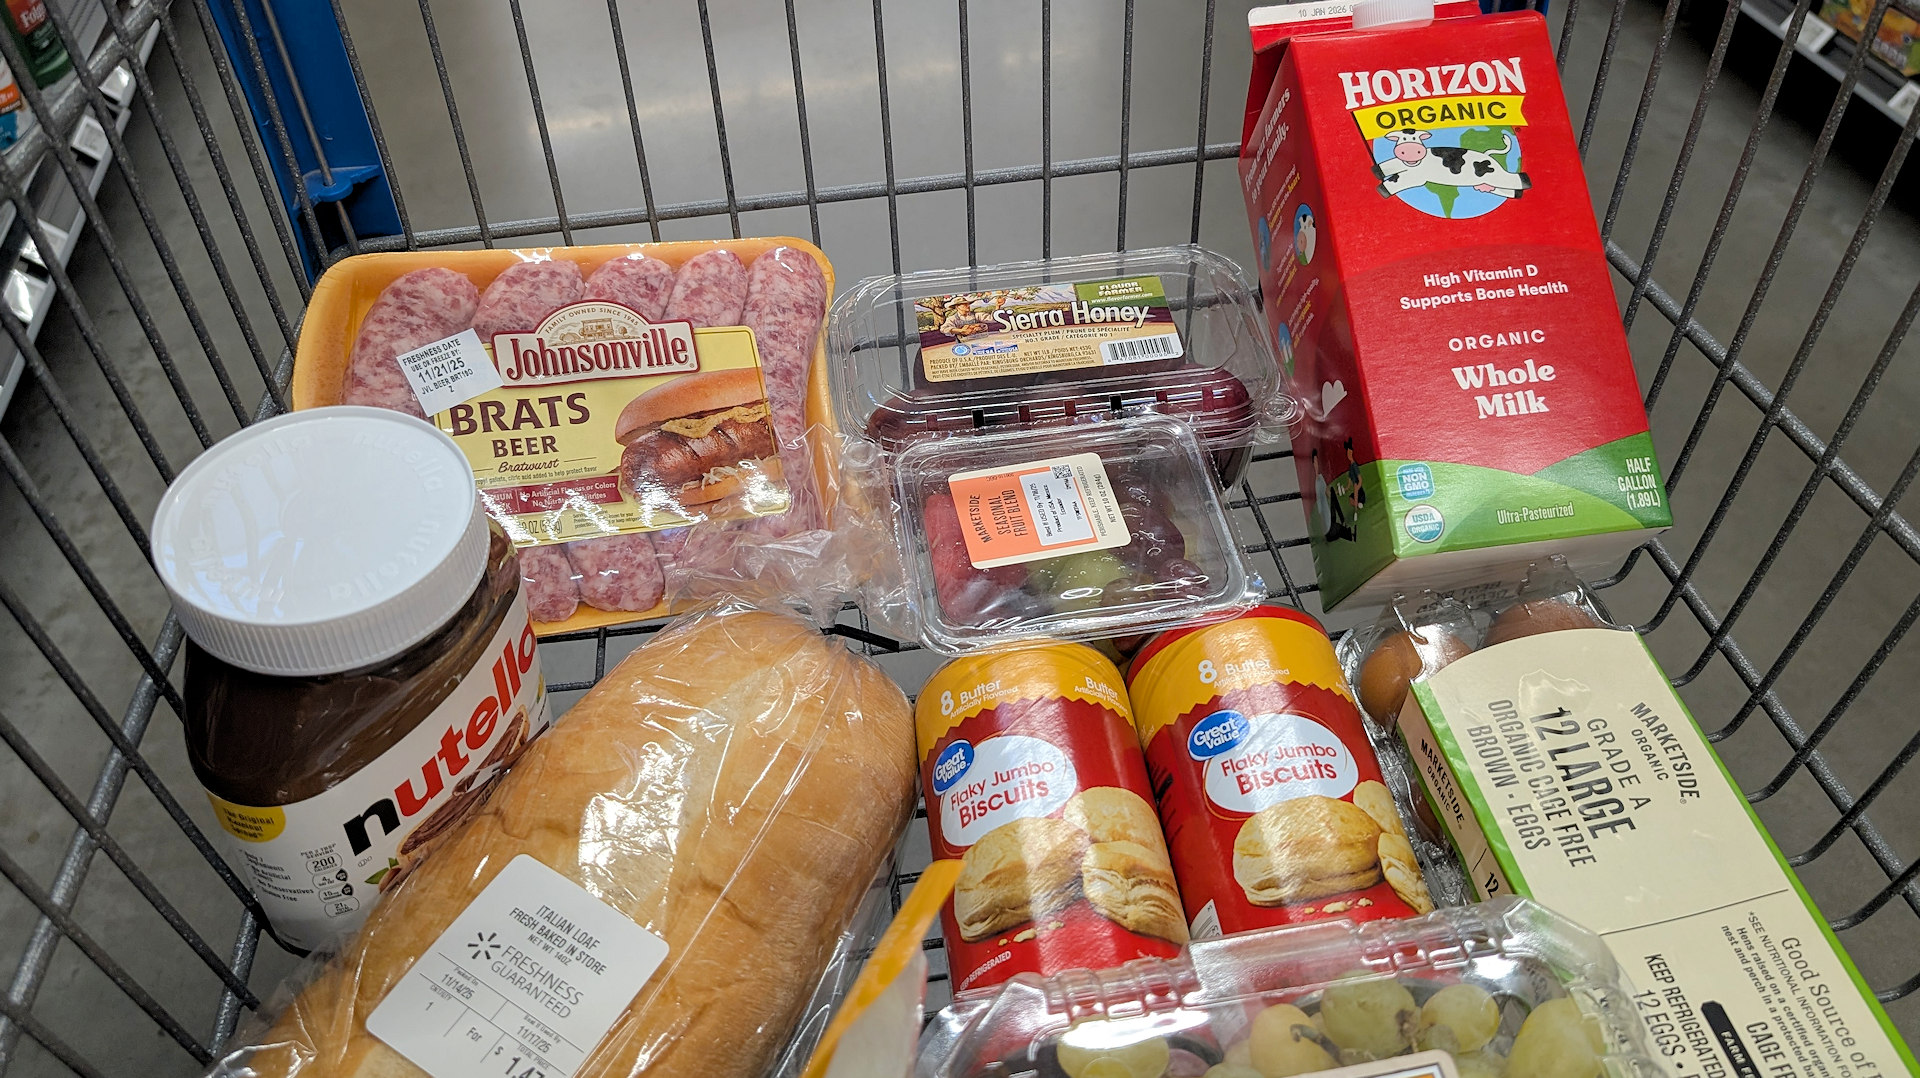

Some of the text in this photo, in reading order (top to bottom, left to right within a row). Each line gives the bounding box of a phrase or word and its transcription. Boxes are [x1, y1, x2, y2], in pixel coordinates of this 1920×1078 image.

[1311, 8, 1325, 16] JAN
[1328, 6, 1347, 15] 2026
[1338, 57, 1526, 110] HORIZON
[1264, 87, 1291, 142] farmers
[1375, 101, 1507, 130] ORGANIC
[1287, 171, 1300, 193] heart
[1099, 281, 1139, 291] FLAVOR
[1423, 264, 1538, 288] High Vitamin D
[1098, 287, 1143, 297] FARMER
[1400, 280, 1569, 311] Supports Bone Health
[545, 307, 639, 334] FAMILY OWNED SINCE 1945
[993, 300, 1150, 334] Sierra Honey
[1012, 332, 1042, 340] SPECIALTY
[1449, 329, 1545, 352] ORGANIC
[402, 338, 461, 366] FRESHNESS DATE
[422, 360, 431, 368] OR
[431, 352, 451, 364] FREEZE
[506, 328, 690, 381] Johnsonville
[992, 357, 1018, 365] KINGSBURG
[418, 357, 465, 383] 11/21/25
[433, 378, 451, 390] BEER
[1451, 359, 1556, 390] Whole
[449, 392, 590, 437] BRATS
[1474, 390, 1549, 420] Milk
[492, 435, 560, 458] BEER
[498, 458, 560, 474] Bratwurst
[533, 465, 598, 479] added help protect flavor
[1402, 472, 1427, 484] NON
[1625, 457, 1652, 474] HALF
[531, 488, 560, 498] Artificial
[594, 481, 616, 490] Colors
[1404, 481, 1429, 492] GMO
[1617, 473, 1656, 493] GALLON
[1002, 489, 1029, 537] FRUIT BLEND
[1104, 505, 1116, 523] NET WT
[1497, 502, 1575, 525] Ultra-Pasteurized
[1627, 489, 1661, 511] (1.89L)
[528, 521, 540, 534] OZ
[969, 494, 992, 543] MARKETSIDE
[988, 496, 1012, 535] SEASONAL
[1411, 523, 1439, 534] ORGANIC
[1412, 513, 1435, 523] USDA
[1198, 658, 1271, 684] 8 Butter
[940, 680, 1001, 716] 8 Butter
[1074, 686, 1106, 702] Artificially
[1085, 676, 1119, 700] Butter
[950, 686, 1019, 720] Artificially Flavored
[343, 622, 536, 857] nutella
[1193, 717, 1240, 746] Great
[1204, 728, 1241, 750] Value
[934, 747, 967, 782] Great
[1220, 742, 1338, 778] Flaky Jumbo
[1586, 716, 1652, 811] GRADE A
[1629, 701, 1700, 799] MARKETSIDE
[1631, 728, 1670, 782] ORGANIC
[942, 761, 967, 784] Value
[950, 761, 1054, 811] Flaky Jumbo
[1235, 758, 1338, 796] Biscuits
[1420, 738, 1465, 824] MARKETSIDE
[1466, 724, 1552, 850] BROWN EGGS
[1488, 698, 1598, 868] ORGANIC CAGE FREE
[1530, 706, 1638, 840] 12 LARGE
[1427, 765, 1451, 812] ORGANIC
[958, 778, 1050, 830] Biscuits
[239, 814, 275, 825] Original
[312, 856, 335, 869] 200
[1484, 871, 1500, 899] 12
[508, 907, 608, 976] FRESH BAKED IN STORE
[536, 905, 601, 950] ITALIAN LOAF
[528, 933, 555, 954] NET WT
[500, 945, 584, 1006] FRESHNESS
[969, 950, 1012, 982] REFRIGERATED
[441, 974, 476, 1000] 11/14/25
[490, 960, 572, 1018] GUARANTEED
[1720, 925, 1808, 1062] nest and perch in protected
[1736, 927, 1812, 1047] Hens raised on certified
[1759, 934, 1801, 996] NUTRITIONAL
[1796, 996, 1842, 1063] INFORMATION
[425, 1002, 434, 1012] 1
[1644, 953, 1676, 984] KEEP
[1662, 986, 1728, 1078] REFRIGERATED
[1780, 937, 1877, 1071] Good Source of
[466, 1026, 483, 1042] For
[1632, 989, 1686, 1057] 12 EGGS
[517, 1025, 552, 1054] 11/17/25
[517, 1044, 534, 1059] TOTAL
[1720, 1030, 1747, 1066] FARM
[1746, 1021, 1786, 1063] CAGE
